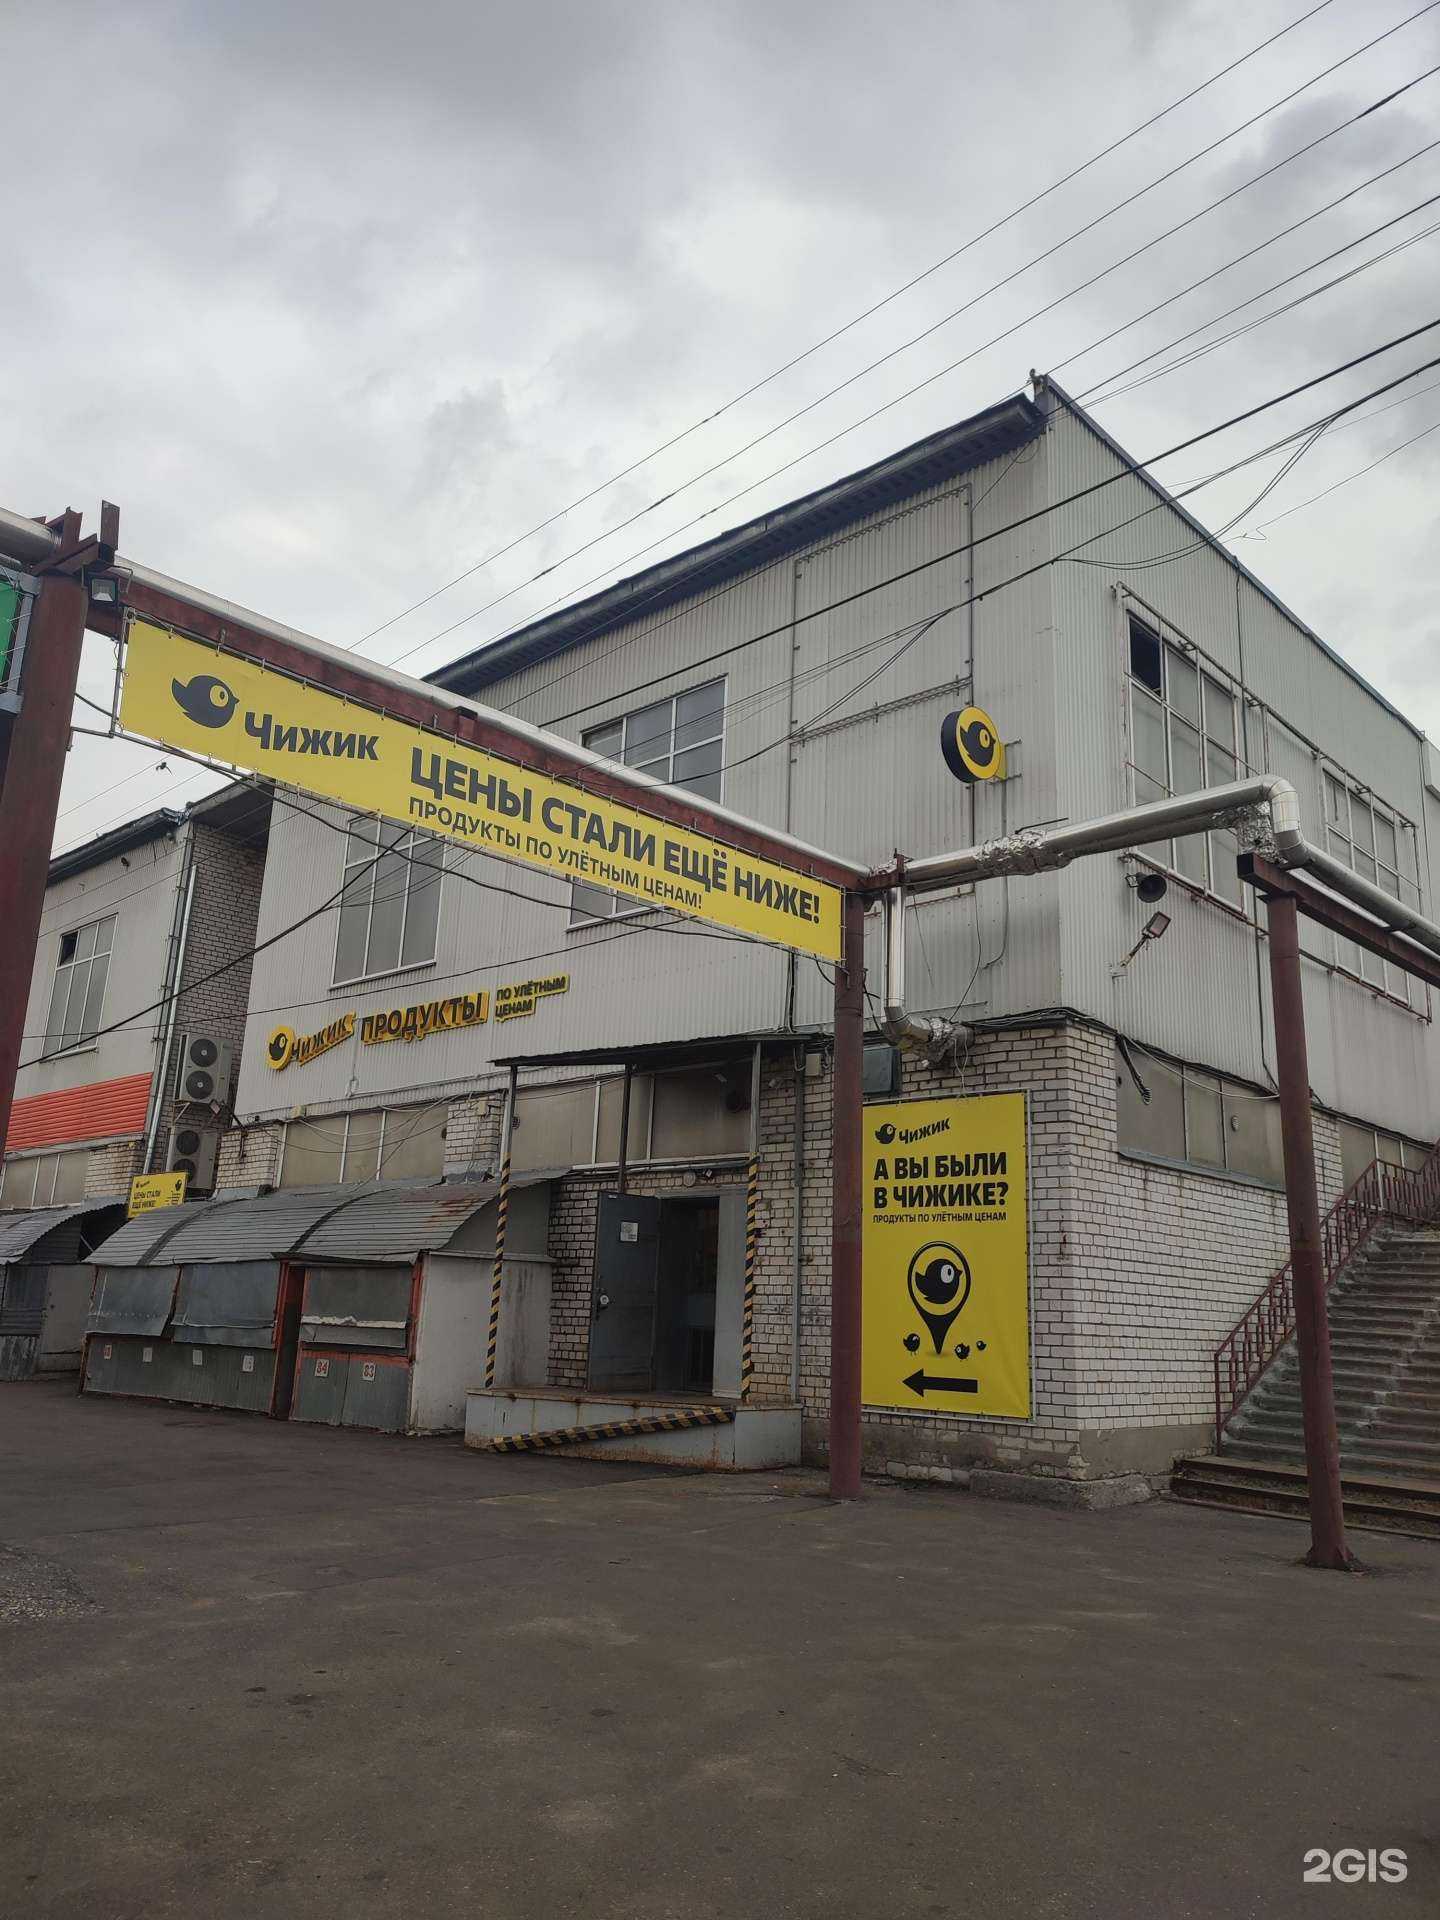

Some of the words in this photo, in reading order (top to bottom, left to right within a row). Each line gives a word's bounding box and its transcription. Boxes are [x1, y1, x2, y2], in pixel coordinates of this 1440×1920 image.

[244, 711, 380, 760] Чижик
[411, 747, 532, 823] ЦЕНЫ
[541, 797, 656, 867] СТАЛИ
[664, 842, 728, 893] ЕЩЁ
[734, 866, 820, 924] НИЖЕ!
[409, 796, 521, 849] ПРОДУКТЫ
[526, 835, 552, 859] ПО
[558, 846, 640, 888] УЛЁТНЫМ
[644, 877, 702, 909] ЦЕНАМ!
[496, 987, 512, 1001] ПО
[513, 975, 567, 998] УЛЁТНЫМ
[361, 991, 484, 1042] ПРОДУКТЫ
[495, 999, 533, 1017] ЦЕНАМ
[899, 1117, 951, 1144] Чижик
[873, 1158, 889, 1181] А
[894, 1156, 929, 1180] ВЫ
[935, 1151, 1007, 1178] БЫЛИ
[874, 1187, 888, 1209] В
[893, 1181, 1009, 1209] ЧИЖИКЕ?
[872, 1213, 916, 1225] ПРОДУКТЫ
[918, 1213, 930, 1223] ПО
[932, 1211, 973, 1223] УЛЁТНЫМ
[975, 1212, 1007, 1223] ЦЕНАМ
